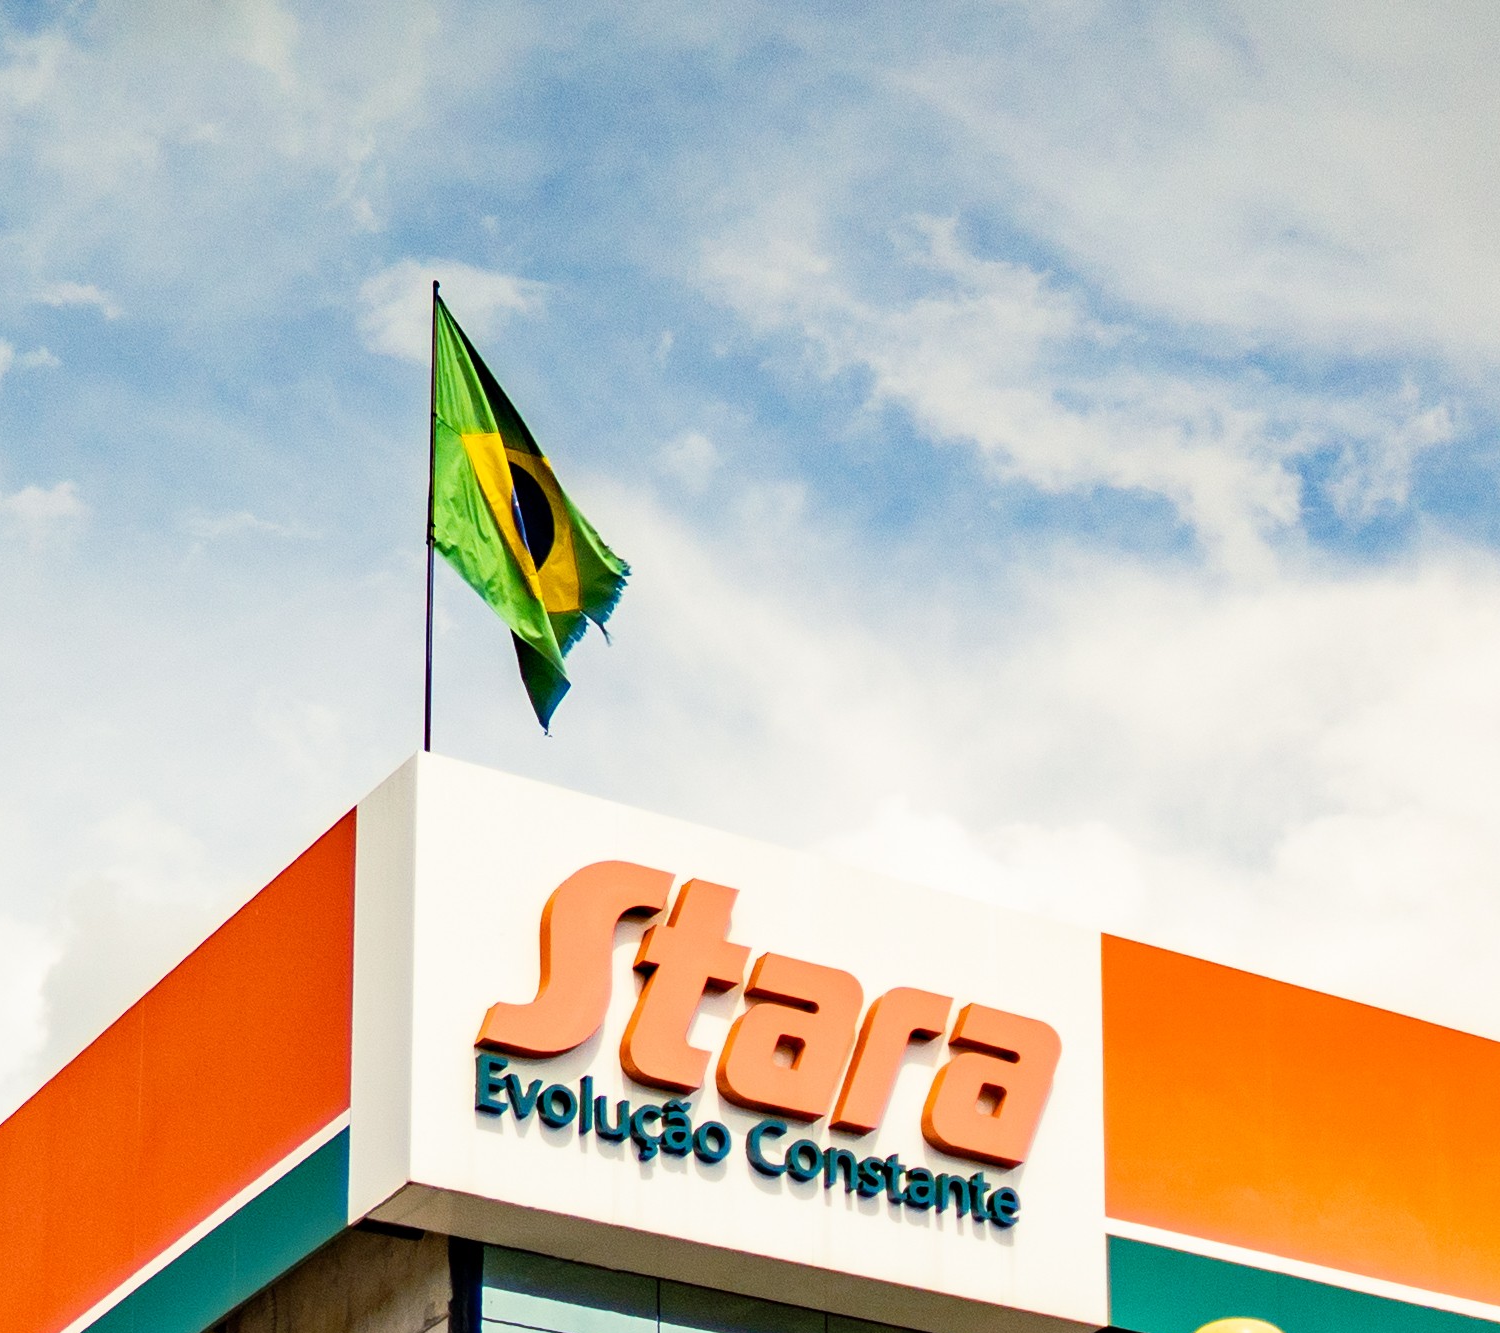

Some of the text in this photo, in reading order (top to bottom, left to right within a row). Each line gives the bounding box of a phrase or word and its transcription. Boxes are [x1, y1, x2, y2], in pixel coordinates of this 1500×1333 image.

[474, 860, 1062, 1168] Stara
[474, 1052, 1022, 1229] Evolução Constante
